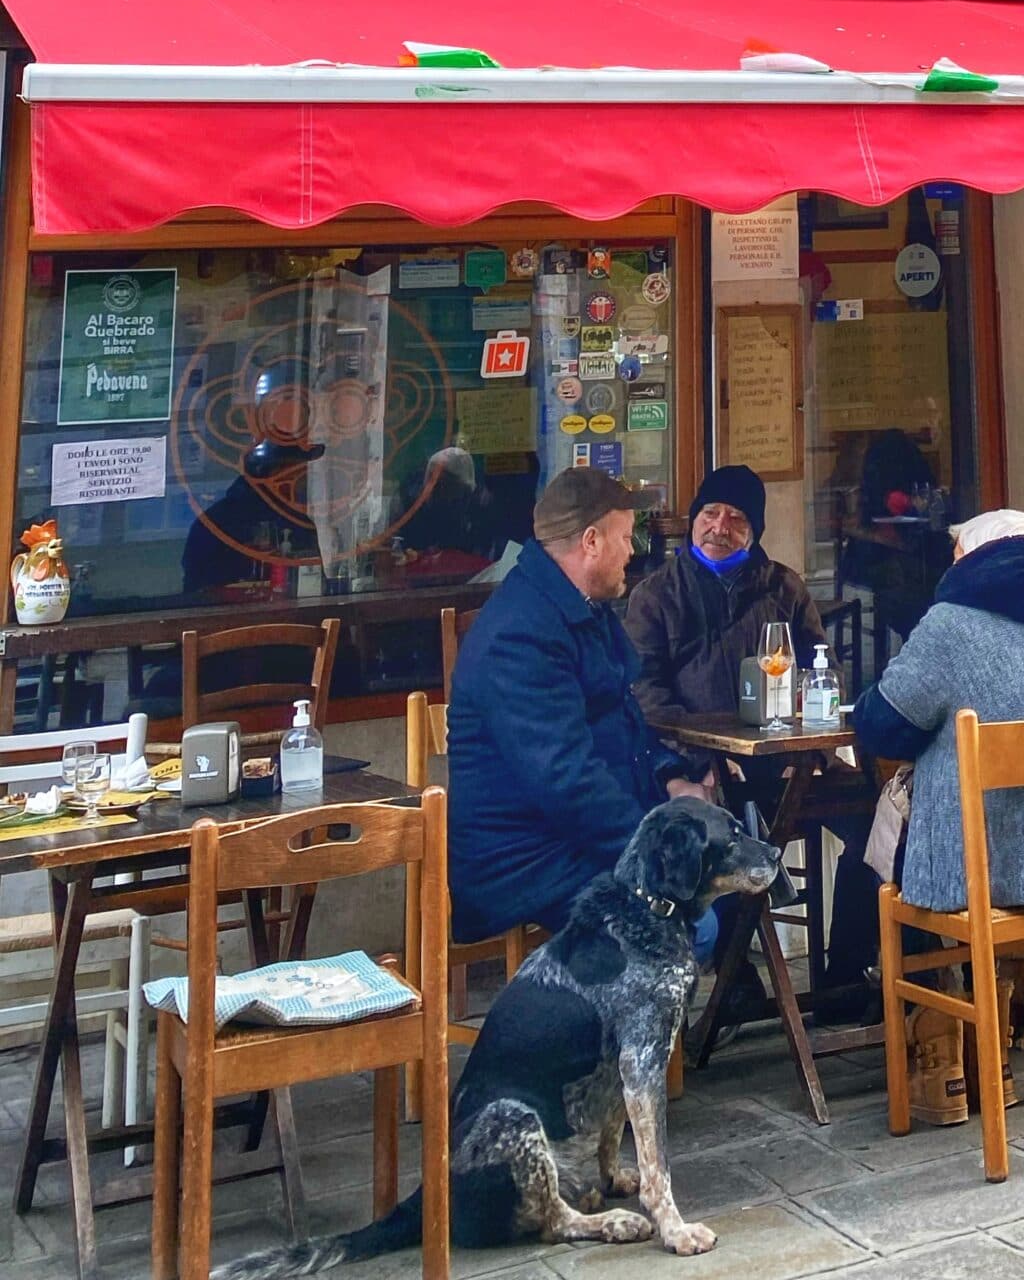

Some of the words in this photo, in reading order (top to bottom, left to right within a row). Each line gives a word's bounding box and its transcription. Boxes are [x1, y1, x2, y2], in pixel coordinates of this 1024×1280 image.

[727, 218, 767, 226] ACCETTANO
[729, 253, 768, 261] PERSONALE
[900, 272, 934, 282] APERTI
[87, 314, 102, 326] Al
[106, 314, 154, 326] Bacaro
[84, 324, 155, 337] Quebrado
[102, 338, 111, 346] si
[112, 338, 137, 346] beve
[103, 346, 134, 355] BIRRA
[86, 362, 149, 397] Pedavena
[96, 448, 107, 458] LE
[109, 447, 129, 458] ORE
[84, 459, 116, 468] TAVOLI
[118, 456, 144, 465] SONO
[79, 468, 122, 479] RISERVATI
[125, 466, 140, 475] AL
[88, 477, 132, 488] SERVIZIO
[79, 486, 138, 499] RISTORANTE
